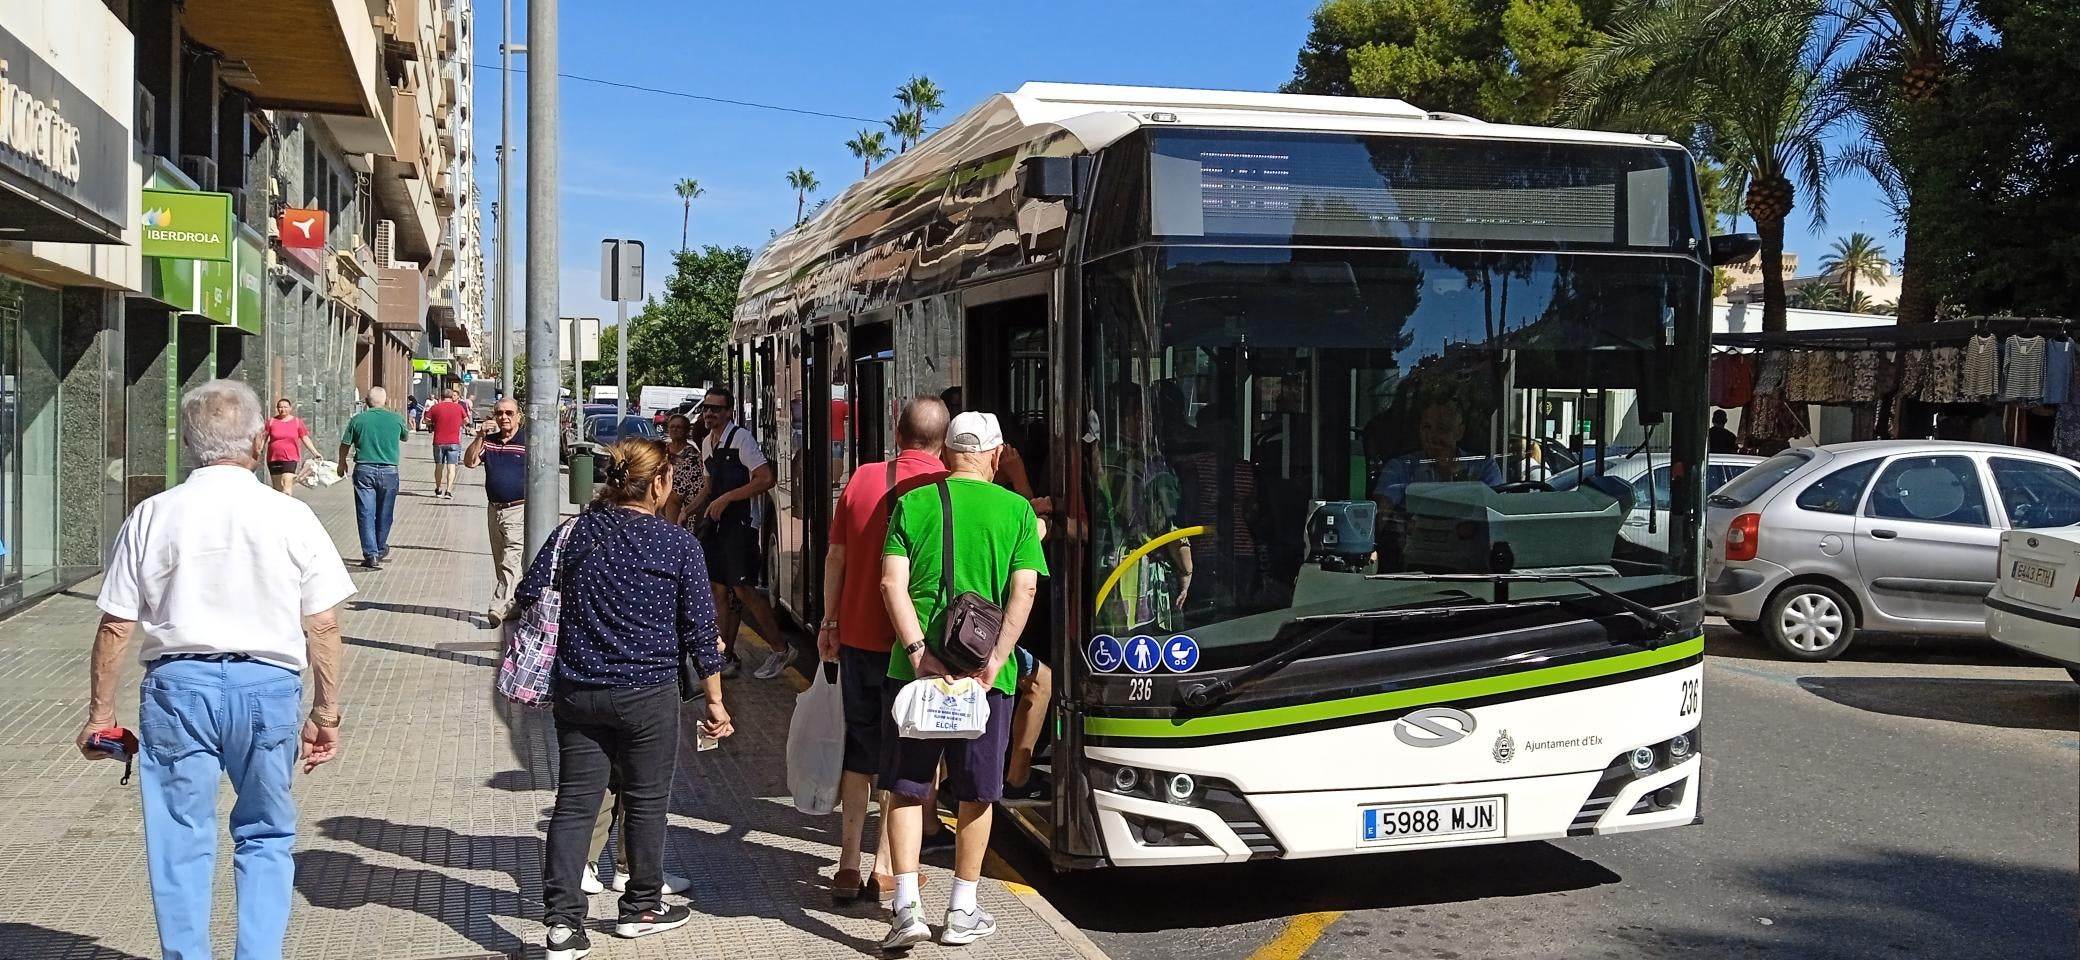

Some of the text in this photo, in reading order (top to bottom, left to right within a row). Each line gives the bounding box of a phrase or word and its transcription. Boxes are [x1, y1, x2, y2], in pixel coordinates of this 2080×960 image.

[147, 230, 220, 243] IBERDROLA
[1129, 678, 1152, 701] 236
[1680, 678, 1699, 717] 236
[935, 721, 958, 730] ELCHE
[1525, 736, 1603, 752] Ajuntament d'Elx
[1383, 809, 1439, 835] 5988
[1451, 805, 1493, 830] MJN
